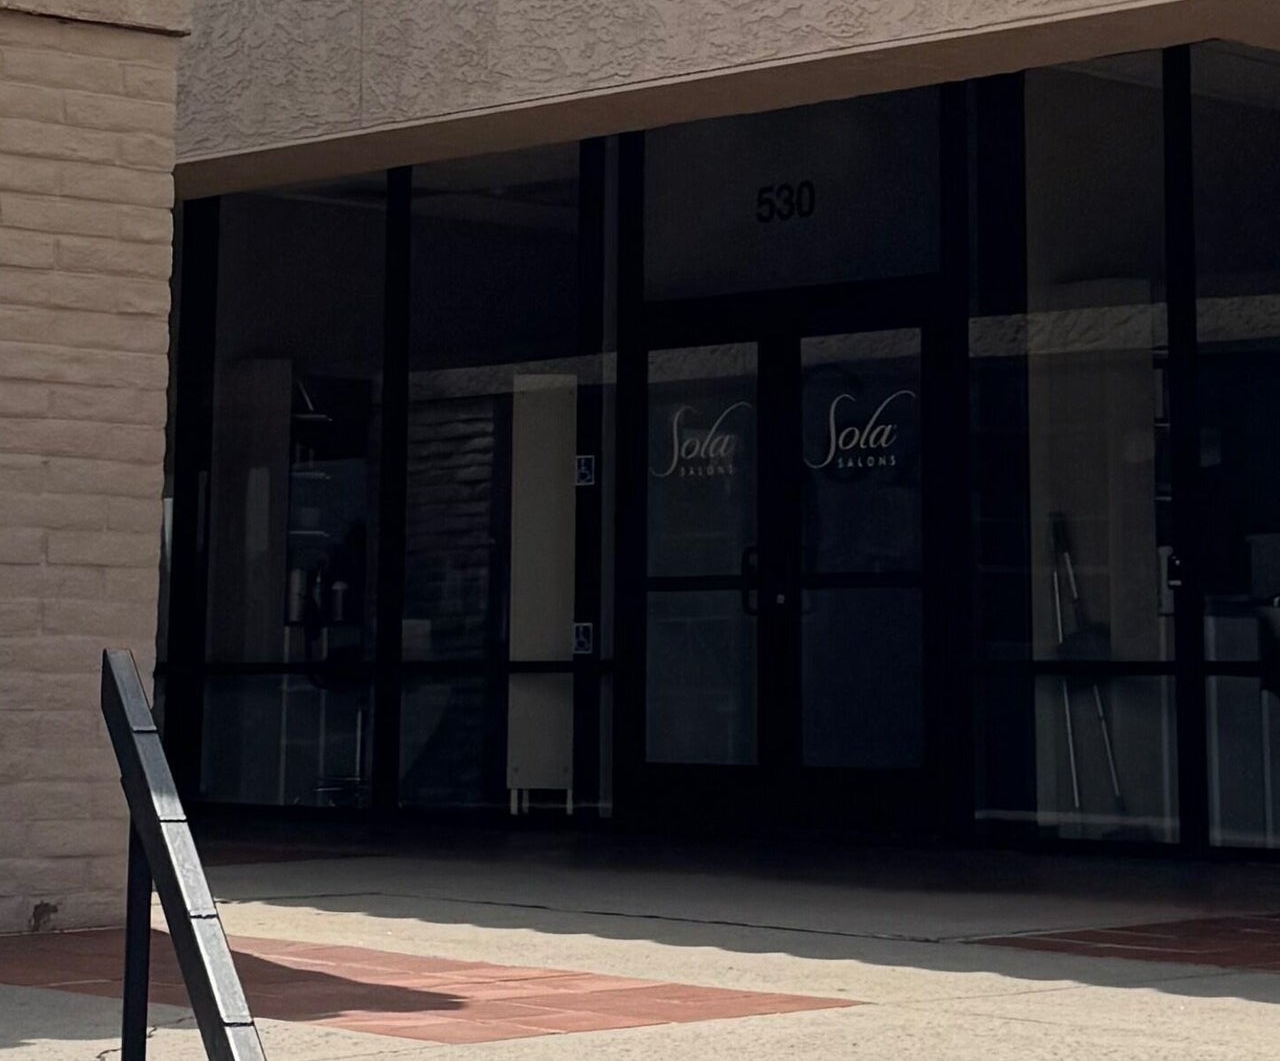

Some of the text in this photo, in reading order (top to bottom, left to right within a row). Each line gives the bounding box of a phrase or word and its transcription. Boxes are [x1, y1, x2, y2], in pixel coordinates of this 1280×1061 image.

[756, 180, 816, 224] 530
[649, 400, 753, 479] Sola
[803, 389, 917, 470] Sola
[837, 454, 897, 469] SALONS
